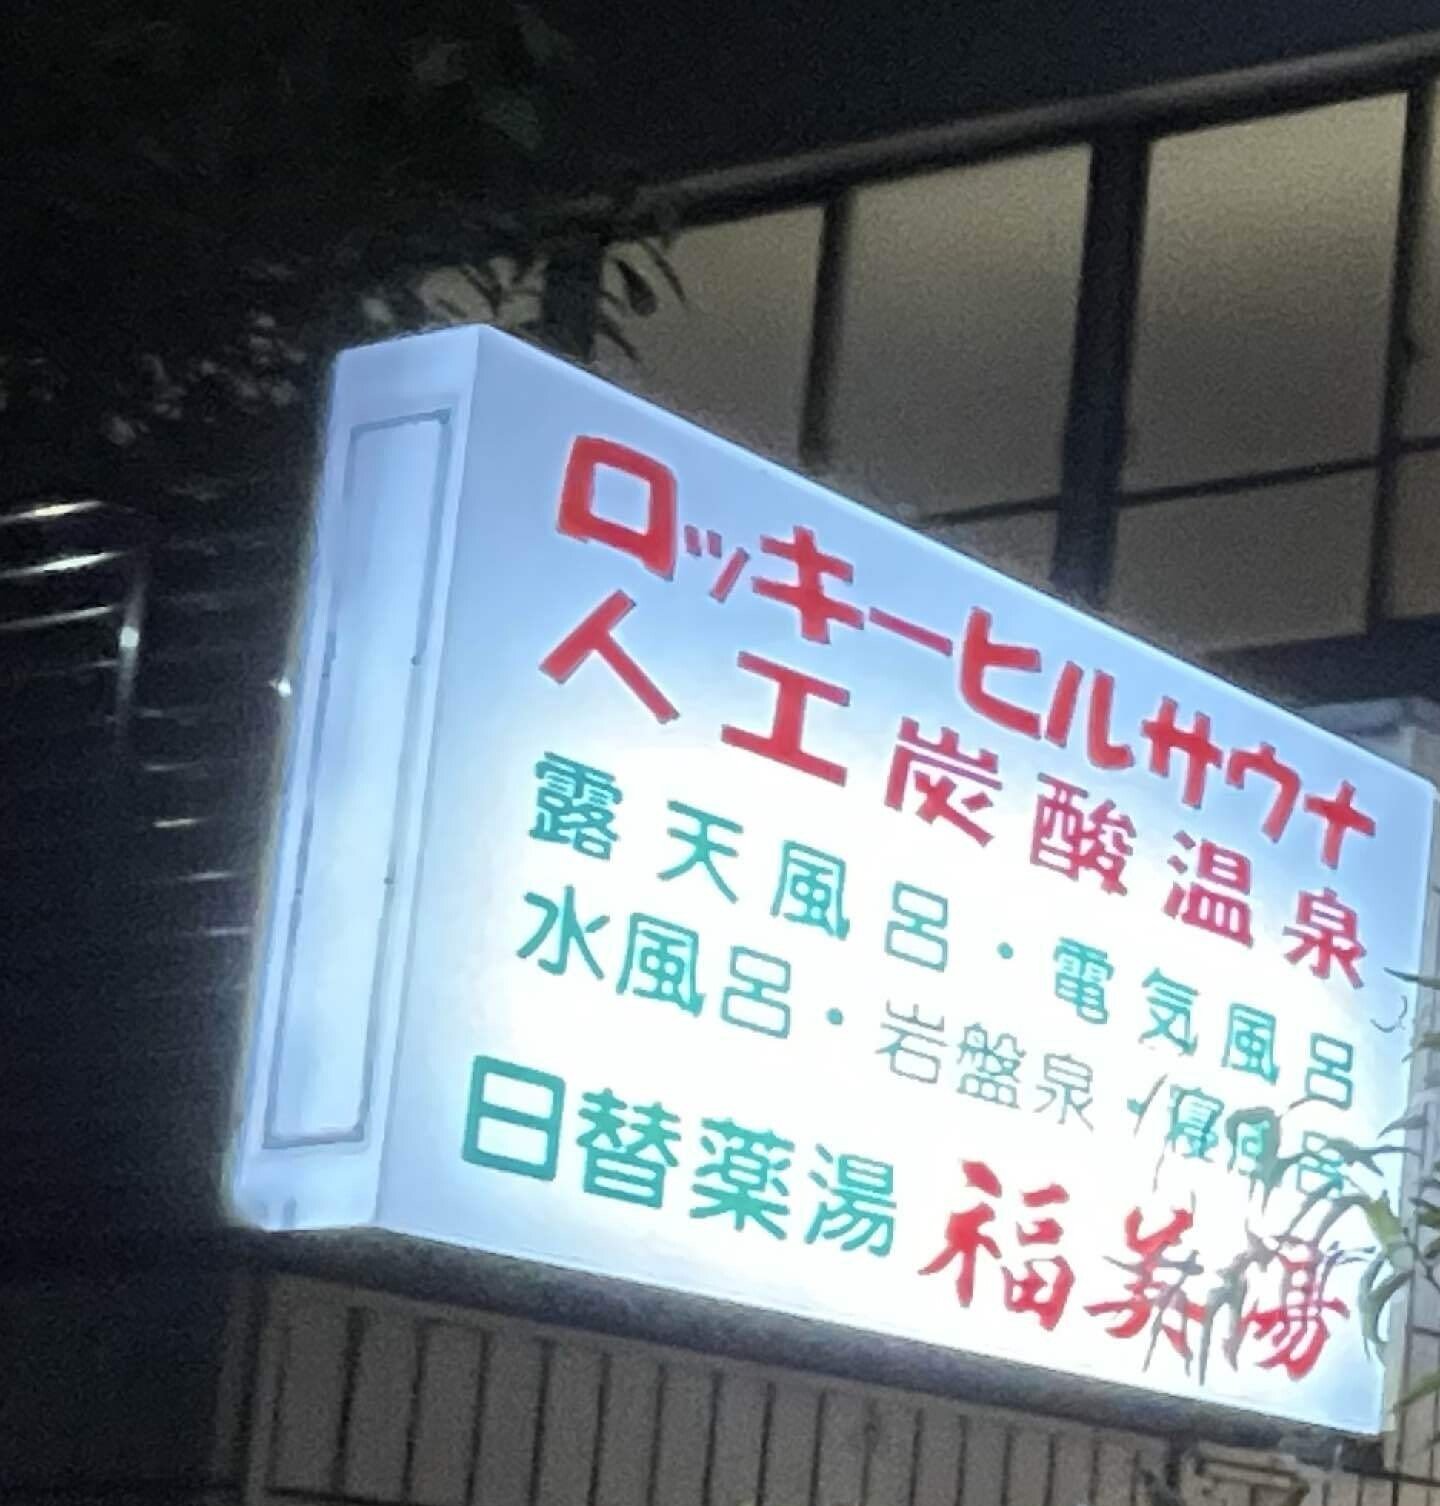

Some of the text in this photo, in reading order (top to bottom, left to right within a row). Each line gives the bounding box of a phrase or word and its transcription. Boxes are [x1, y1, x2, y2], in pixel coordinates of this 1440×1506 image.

[539, 588, 1368, 989] 人工炭酸温泉
[555, 434, 1377, 869] ロッキーヒルサウナ
[527, 751, 1355, 1110] 露天風呂・電気風呂
[460, 1053, 897, 1258] 日替薬湯
